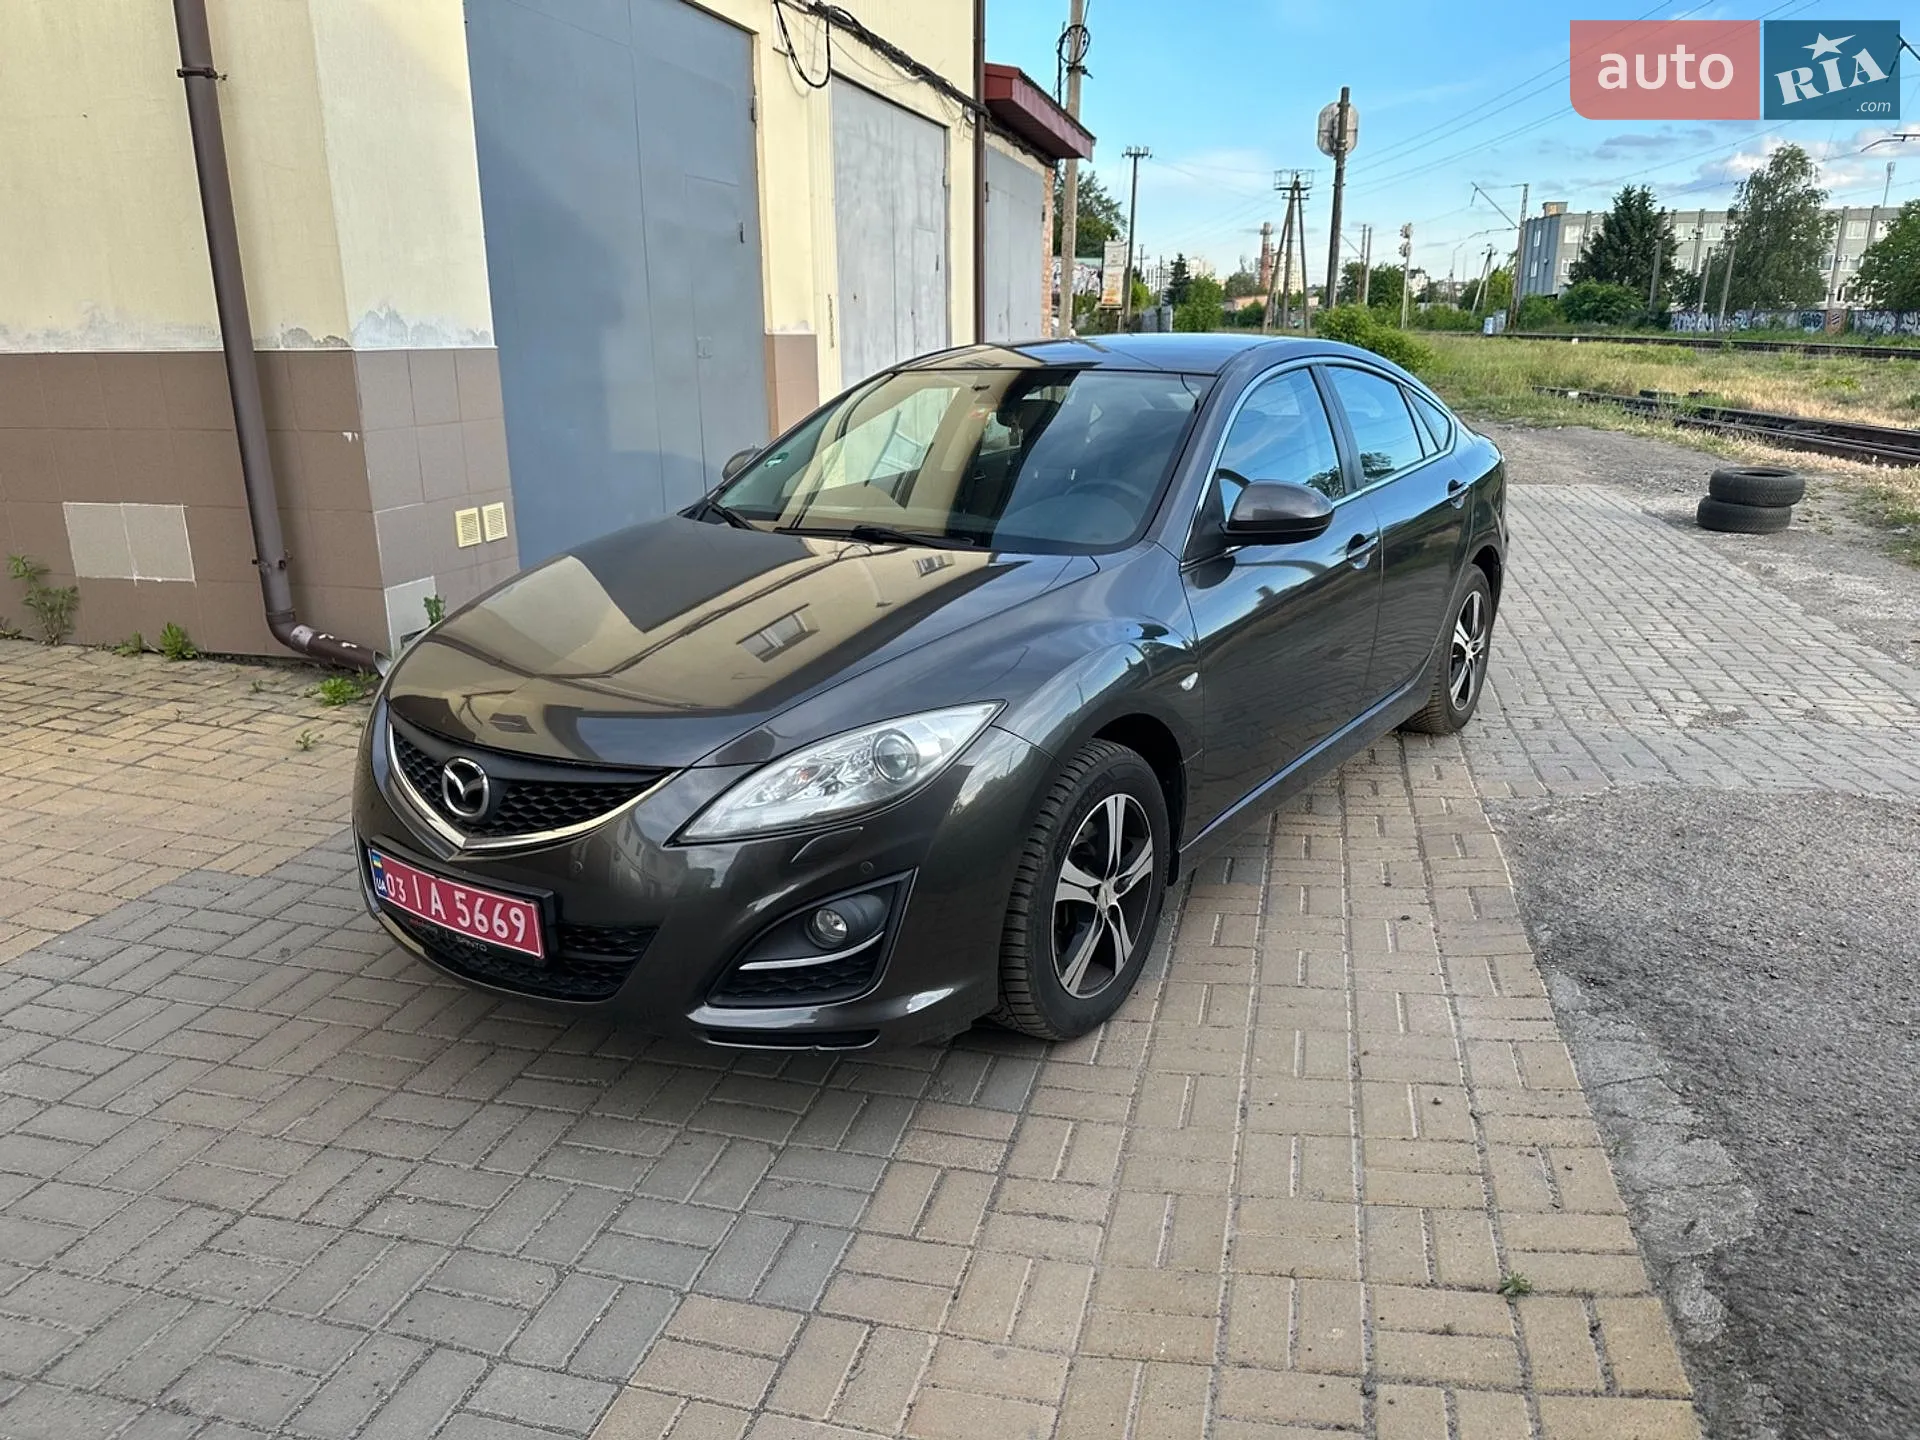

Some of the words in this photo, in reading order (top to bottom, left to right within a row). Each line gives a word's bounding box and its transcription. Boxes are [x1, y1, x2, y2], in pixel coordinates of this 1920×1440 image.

[376, 877, 387, 892] UA
[385, 873, 407, 903] 03
[454, 890, 526, 943] 5669
